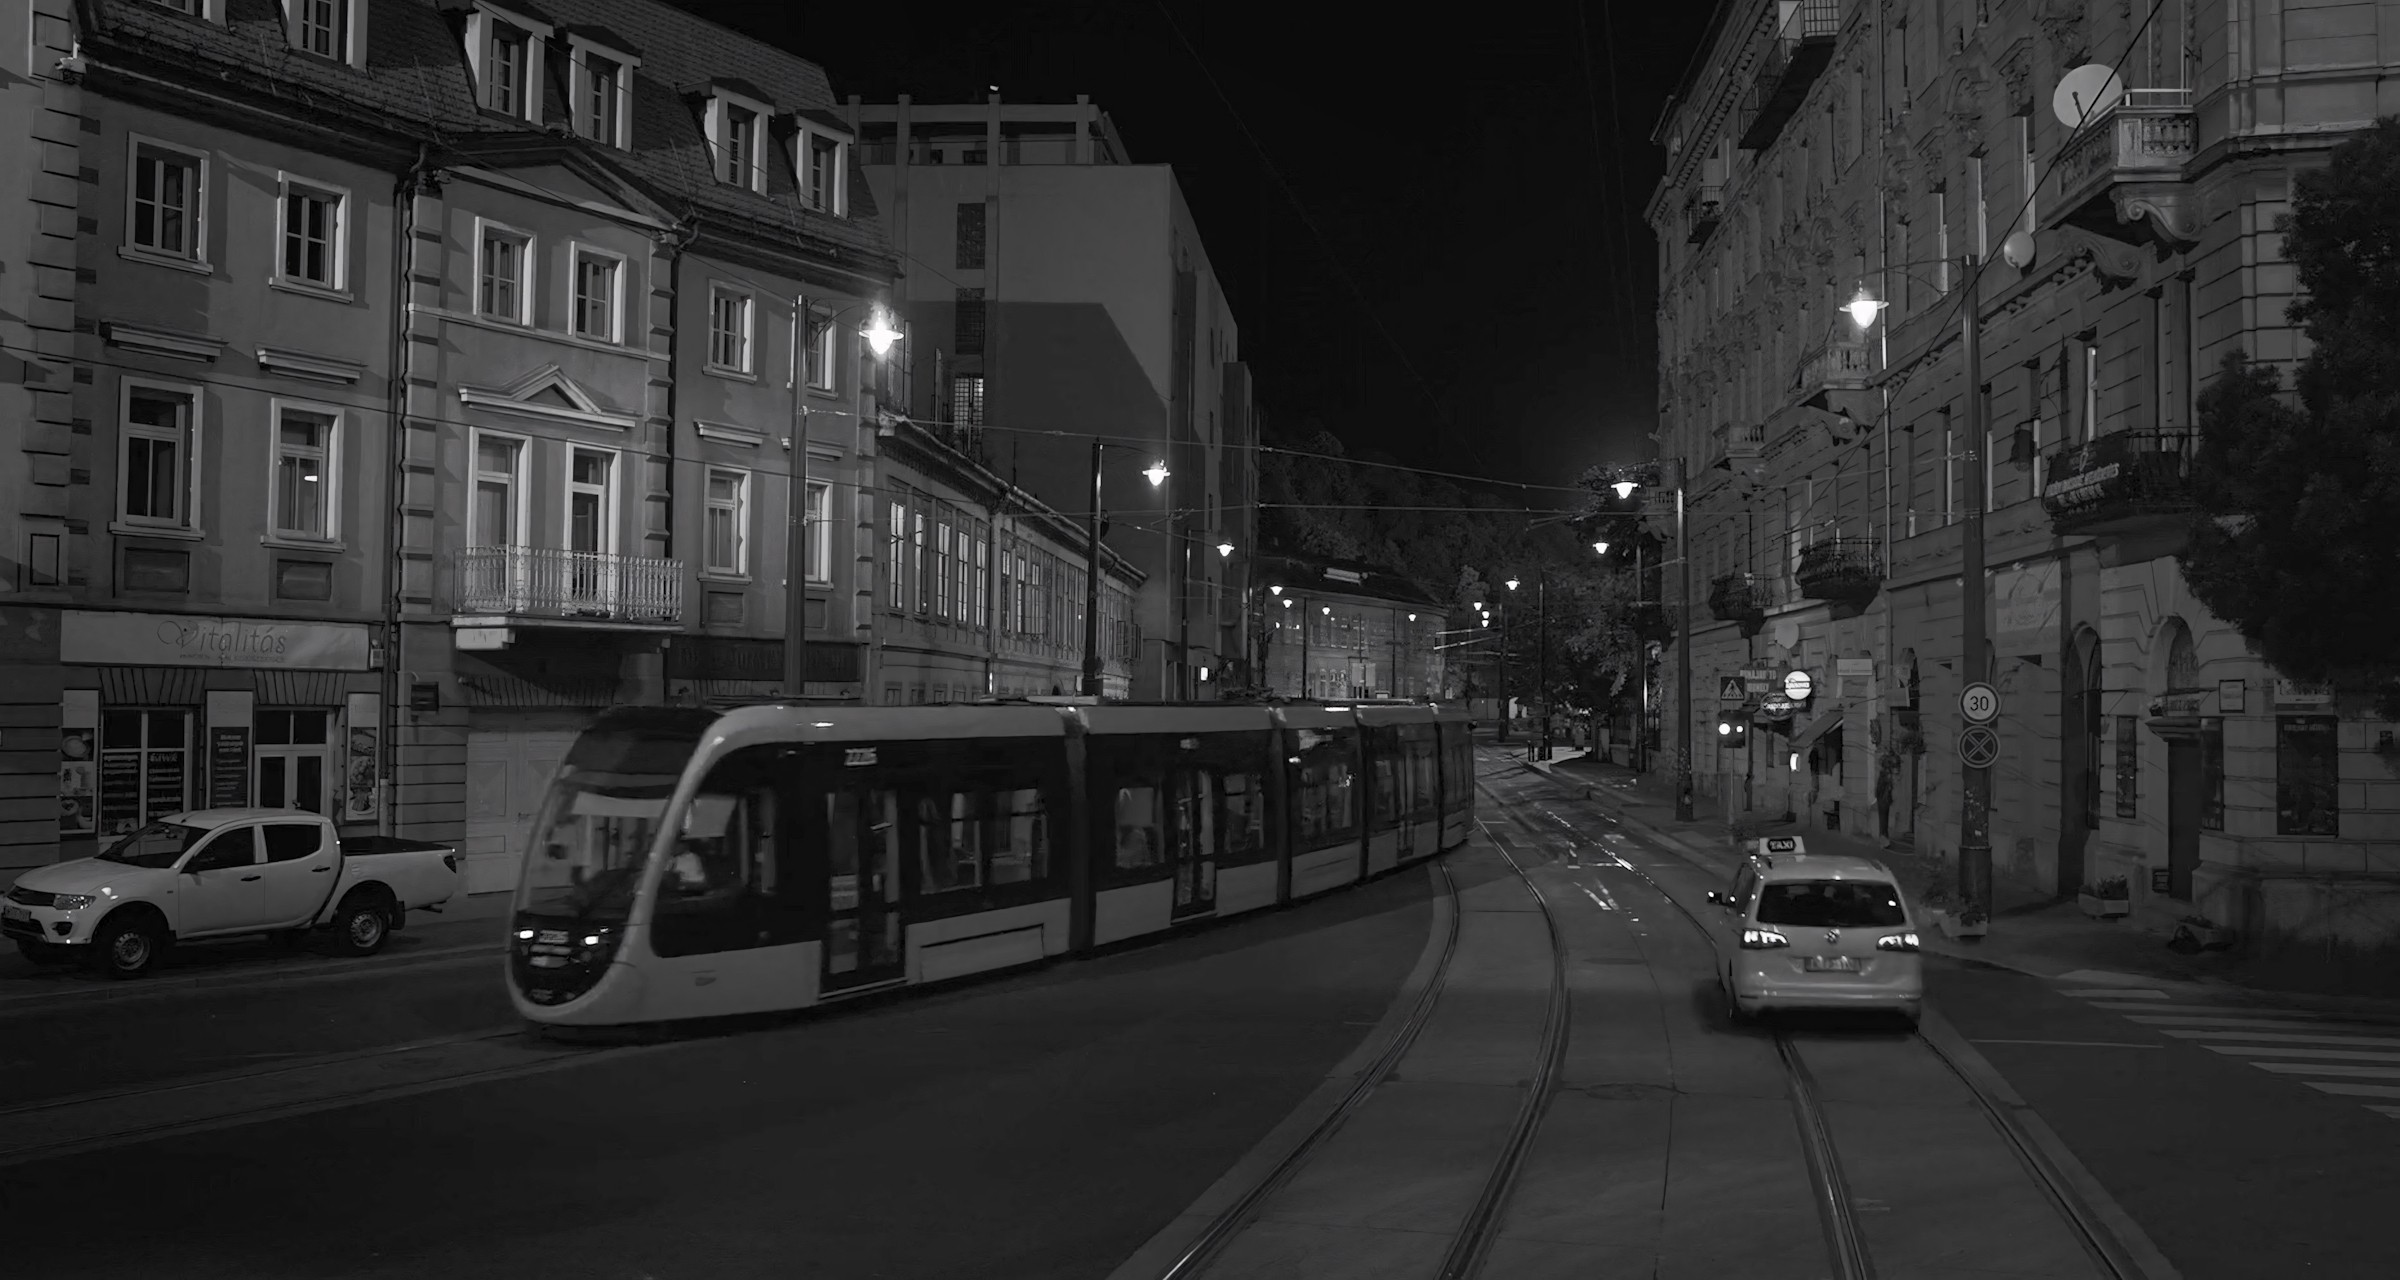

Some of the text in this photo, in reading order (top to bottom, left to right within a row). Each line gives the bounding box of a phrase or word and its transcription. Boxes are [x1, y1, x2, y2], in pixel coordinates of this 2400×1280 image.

[157, 620, 287, 654] Vitalitás
[1969, 695, 1989, 712] 30
[1769, 839, 1794, 851] TAXI
